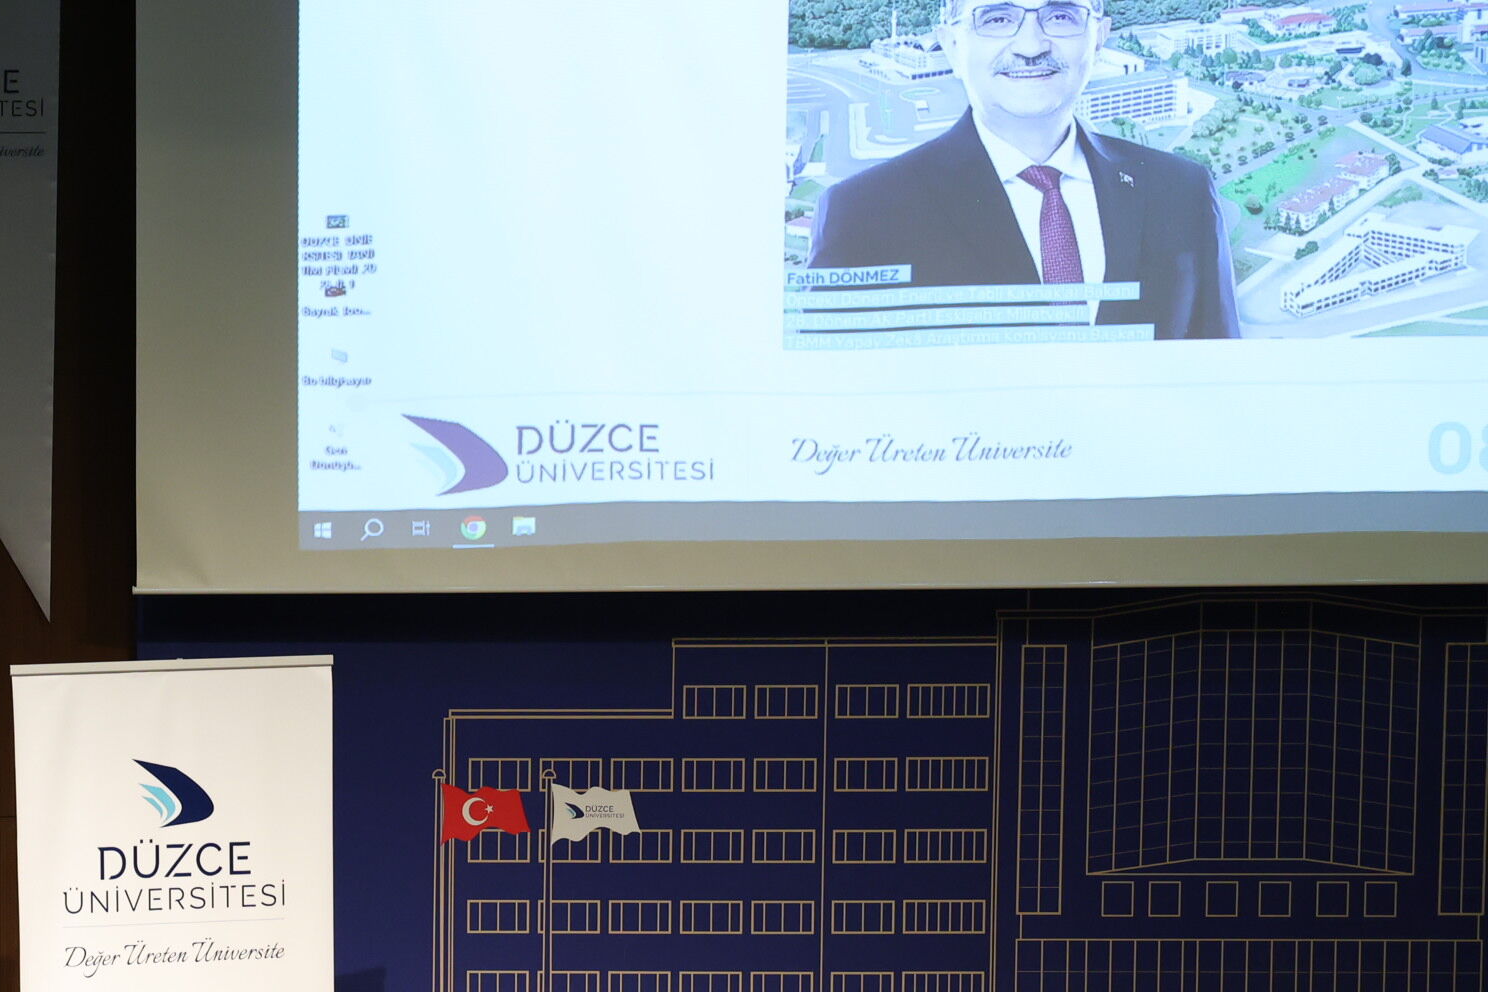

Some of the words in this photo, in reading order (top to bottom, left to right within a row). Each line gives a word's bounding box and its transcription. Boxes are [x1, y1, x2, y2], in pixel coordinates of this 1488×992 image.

[787, 272, 825, 285] Fatih
[829, 268, 900, 284] DÖNMEZ
[516, 419, 659, 455] DÜZCE
[791, 438, 861, 475] Değer
[865, 433, 946, 463] Üreten
[952, 432, 1072, 461] Üniversite
[1428, 421, 1488, 474] 0
[516, 458, 714, 483] ÜNİVERSİTESİ
[97, 839, 251, 880] DÜZCE
[62, 879, 285, 914] ÜNİVERSİTESİ
[64, 946, 121, 978] Değer
[124, 939, 189, 966] Üreten
[192, 937, 286, 964] Üniversite
